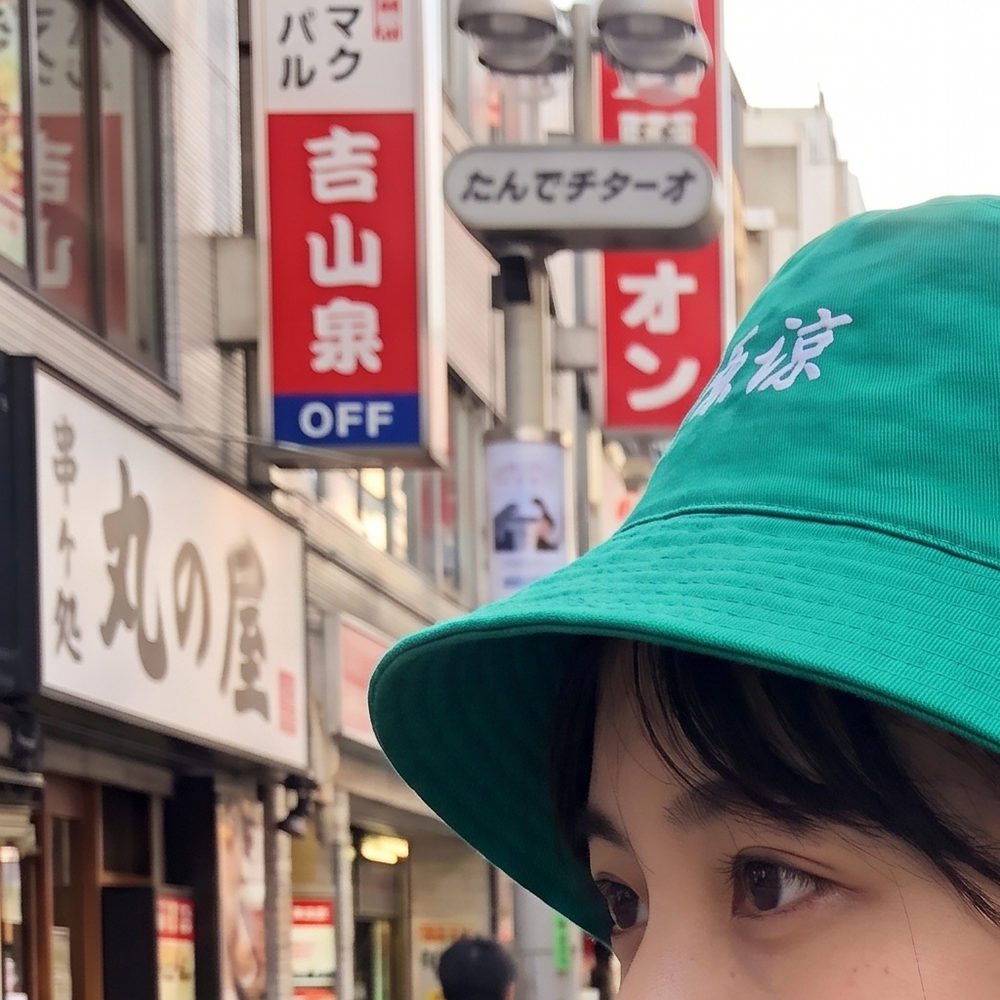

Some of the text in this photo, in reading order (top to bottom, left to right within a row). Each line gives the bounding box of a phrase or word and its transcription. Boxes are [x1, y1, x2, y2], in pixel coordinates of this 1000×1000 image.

[304, 124, 385, 375] 吉山泉
[299, 401, 394, 438] OFF
[100, 455, 271, 724] 丸の屋
